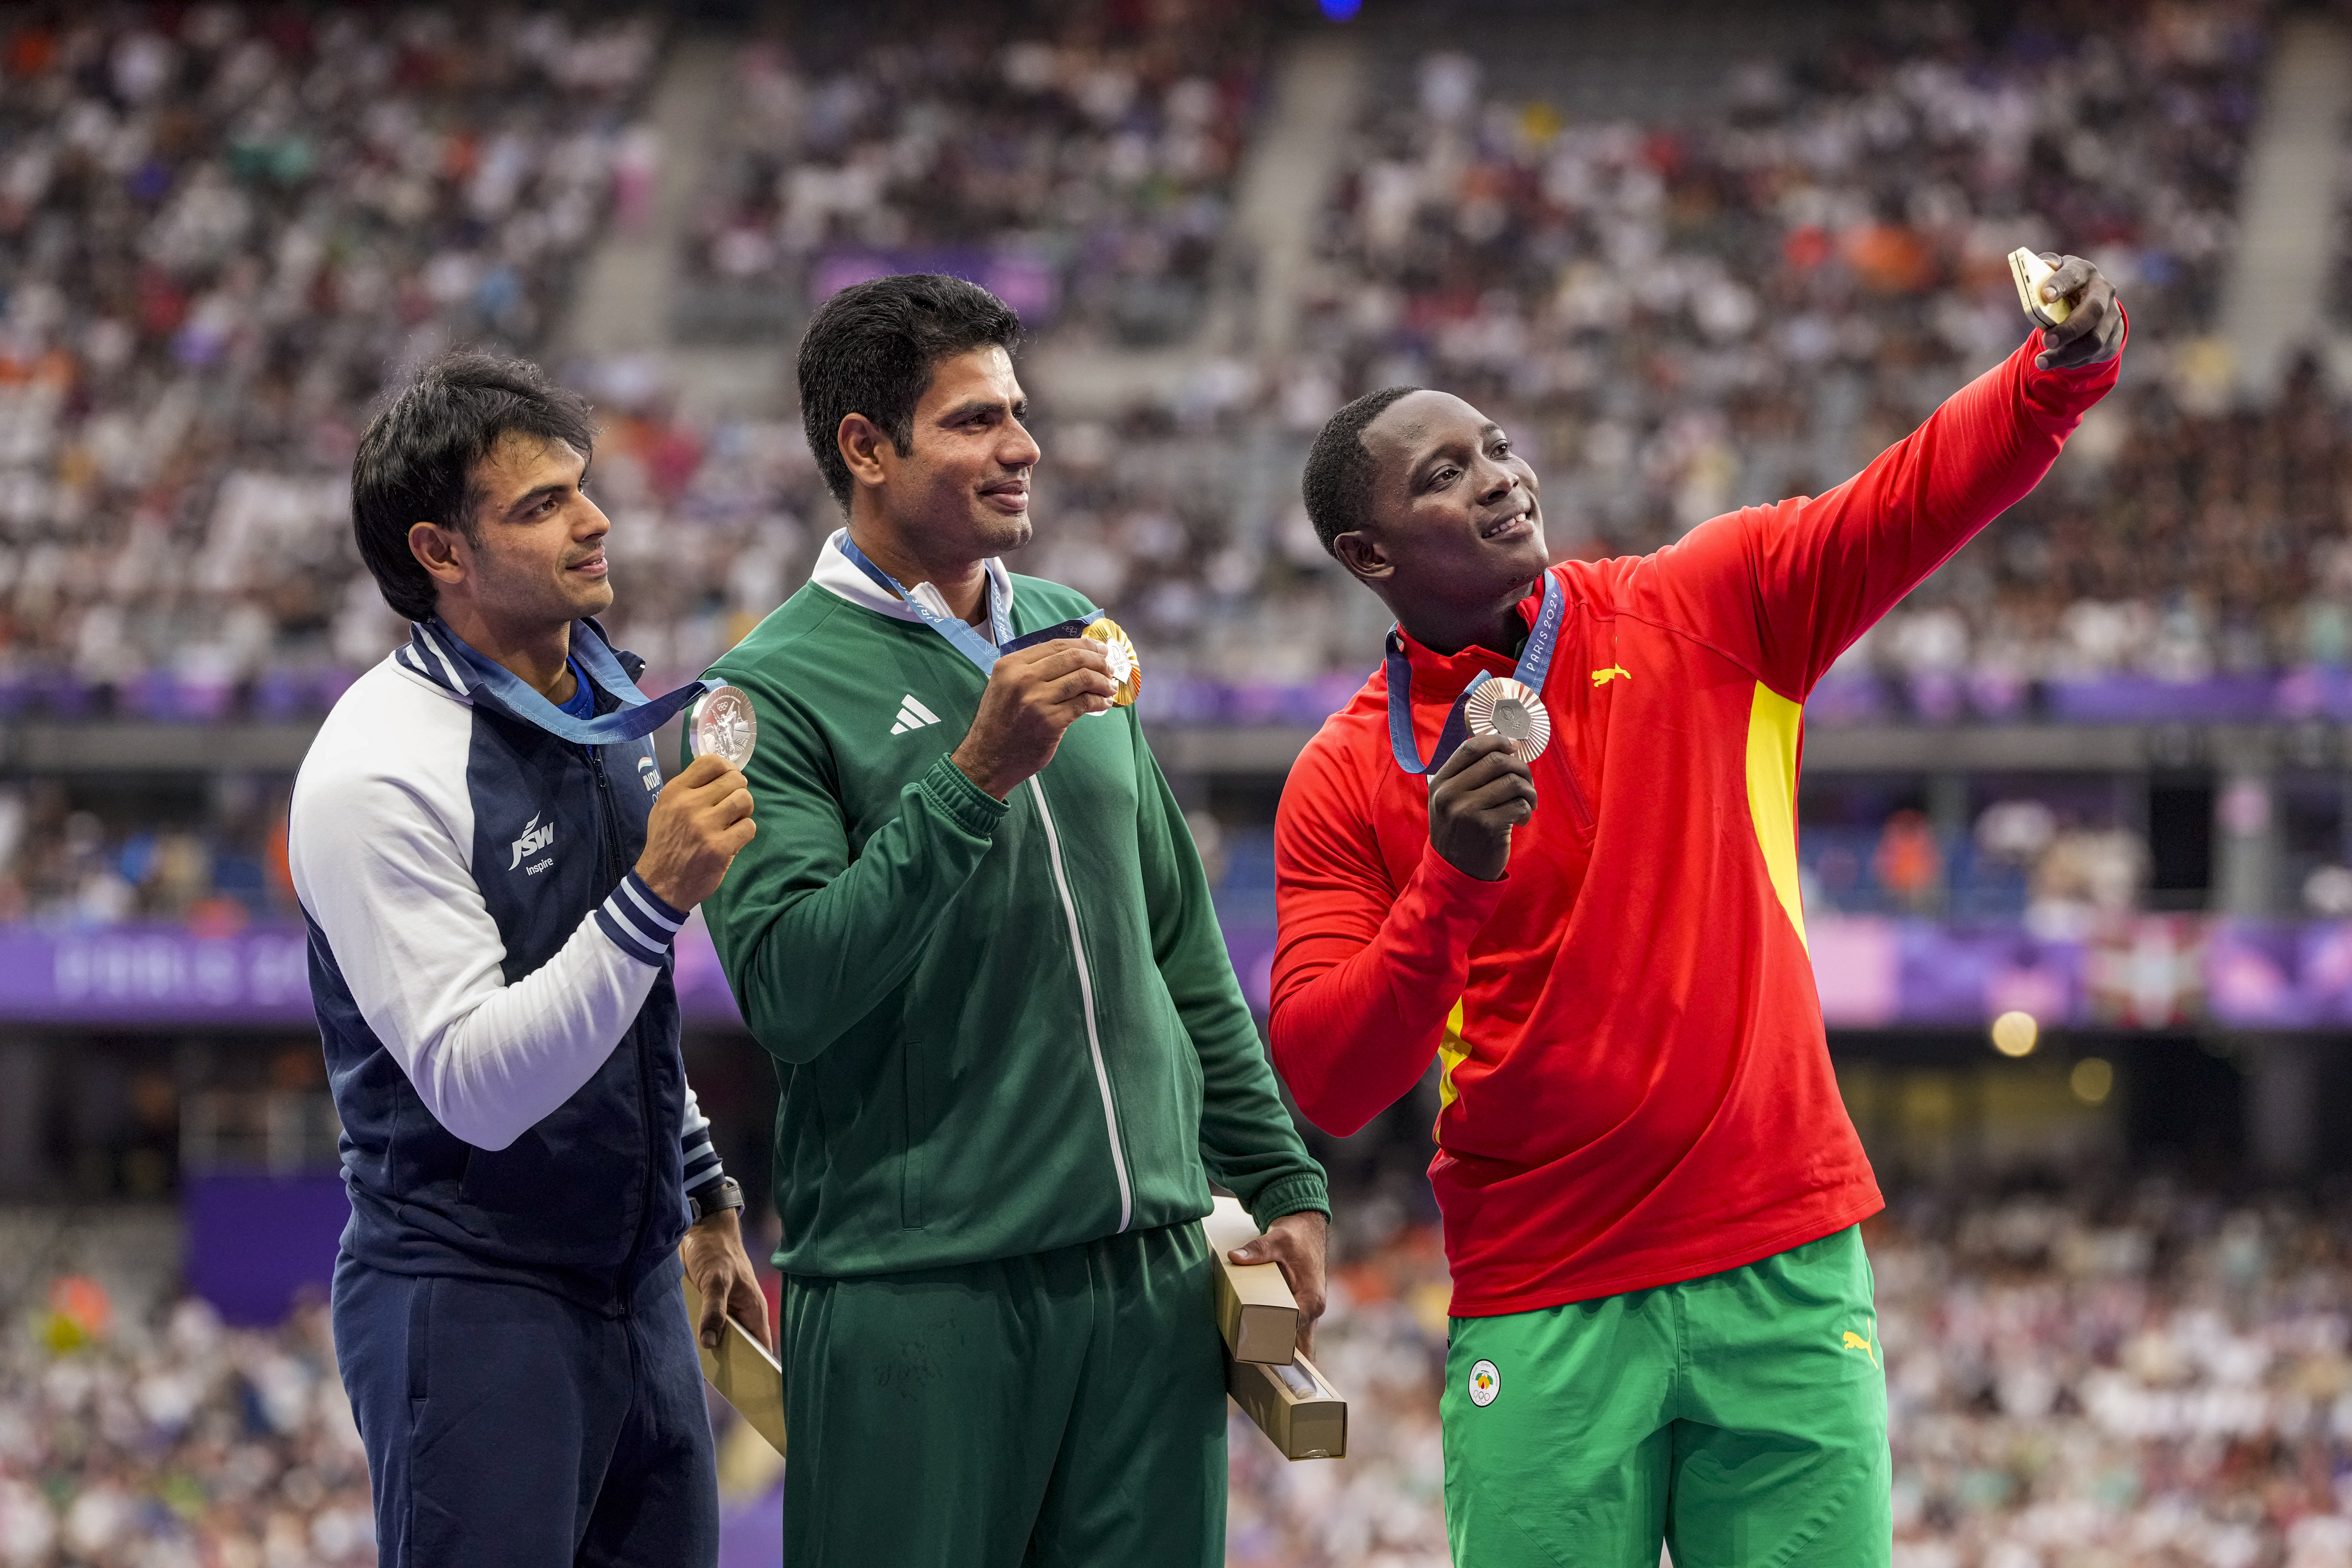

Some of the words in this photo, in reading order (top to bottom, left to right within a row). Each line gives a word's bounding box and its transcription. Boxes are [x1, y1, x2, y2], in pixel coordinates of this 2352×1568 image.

[1544, 592, 1558, 630] 2024
[642, 769, 661, 791] INDIA
[508, 820, 554, 871] JSW
[526, 858, 554, 876] Inspire
